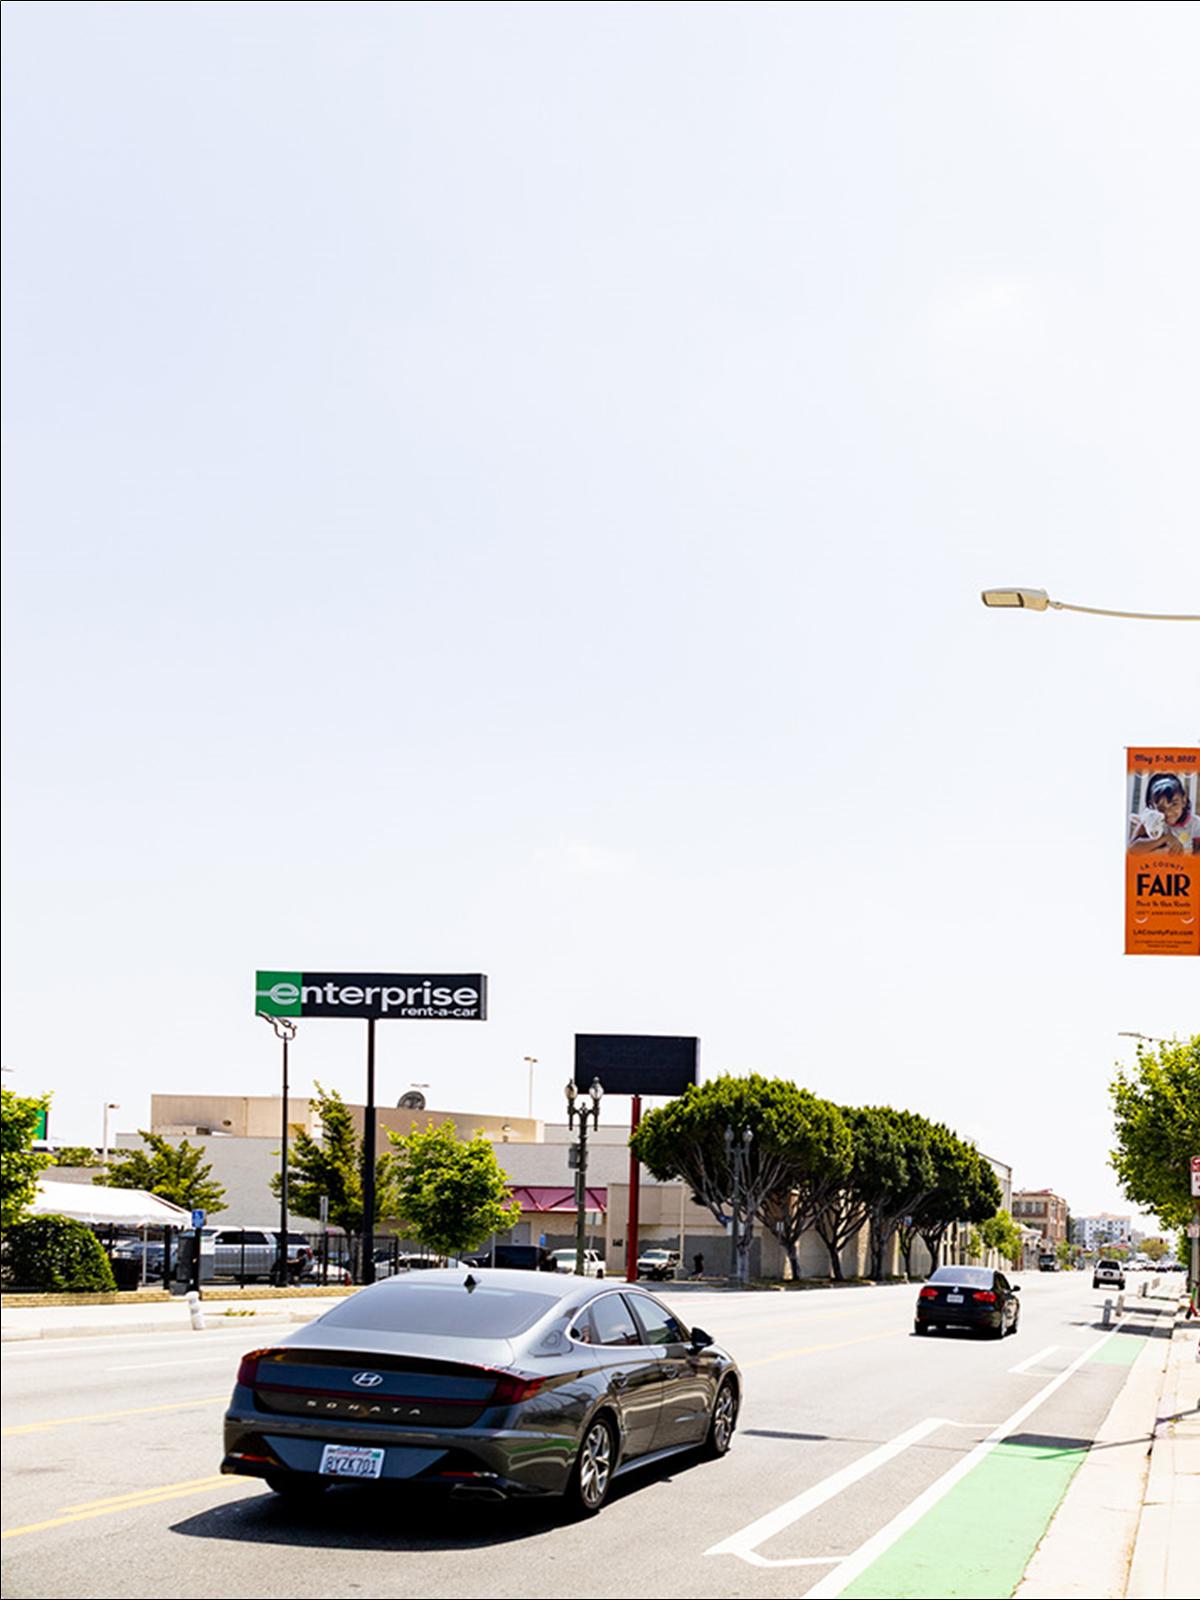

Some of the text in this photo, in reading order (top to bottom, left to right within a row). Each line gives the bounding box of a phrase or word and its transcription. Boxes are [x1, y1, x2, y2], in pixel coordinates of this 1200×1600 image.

[1153, 861, 1184, 870] COUNTY
[1137, 874, 1190, 896] FAIR
[268, 981, 478, 1012] enterprise
[401, 1006, 478, 1017] rent-a-car
[307, 1400, 420, 1415] SONATA
